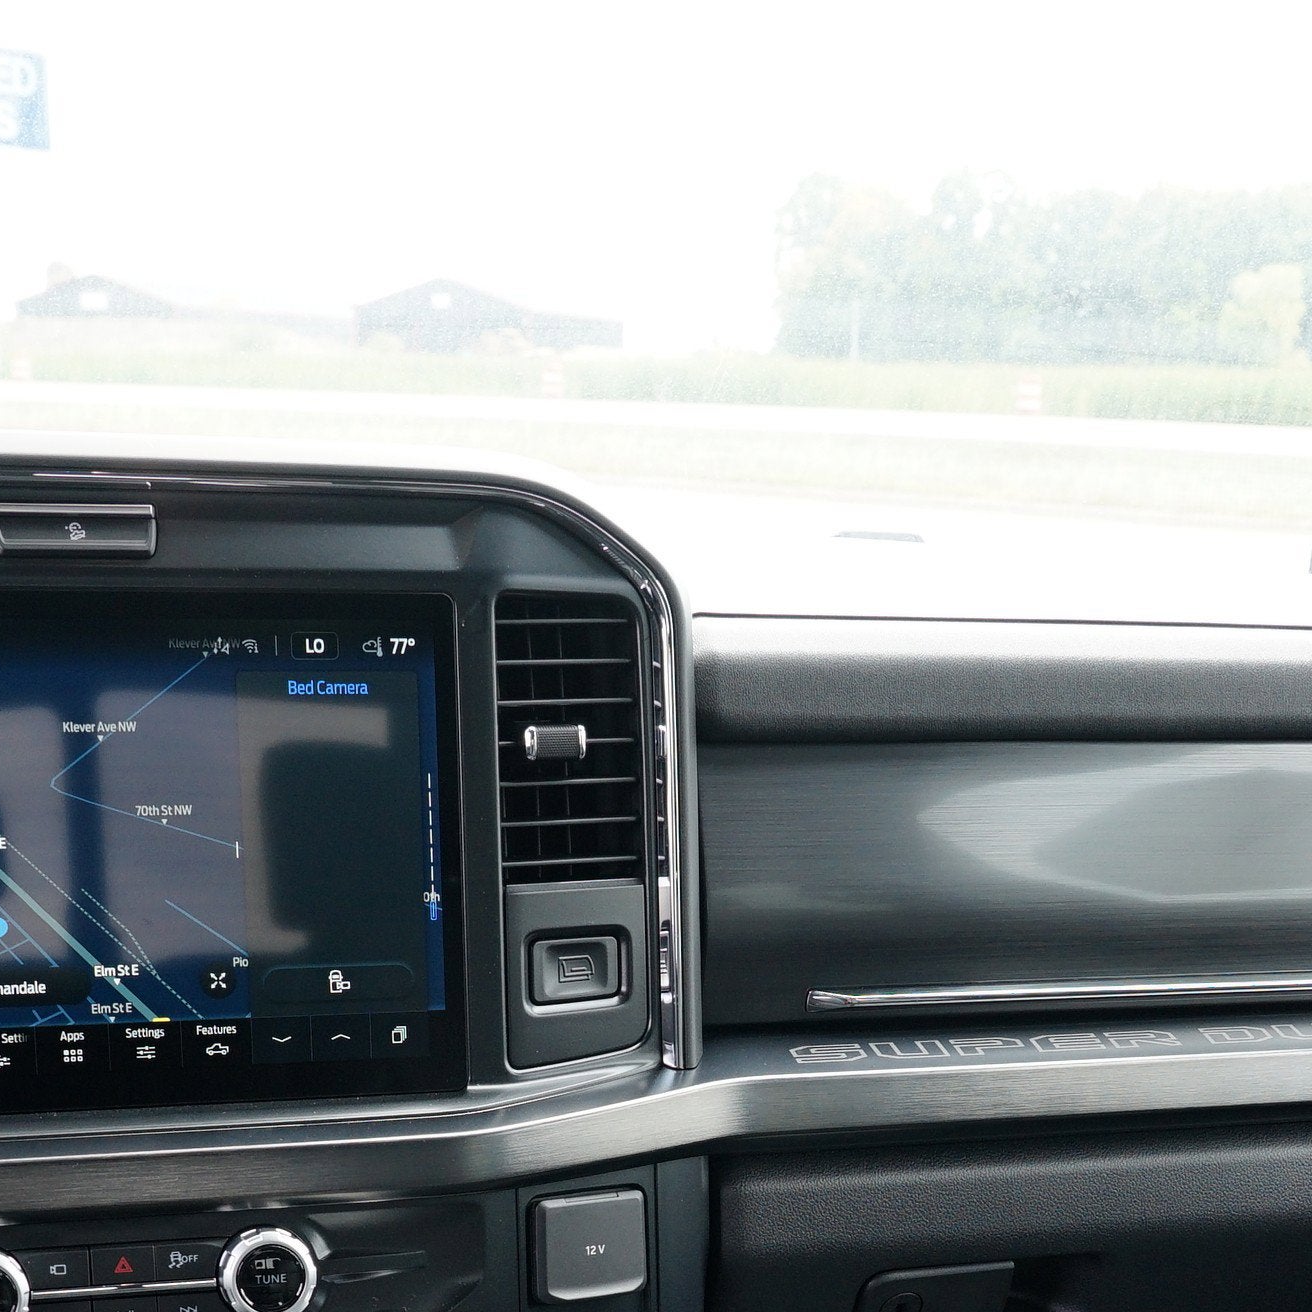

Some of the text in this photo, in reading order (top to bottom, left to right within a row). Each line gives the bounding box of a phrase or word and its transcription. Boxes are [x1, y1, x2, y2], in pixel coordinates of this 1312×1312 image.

[305, 637, 416, 655] LO 77°
[288, 680, 369, 696] Bed Camera
[63, 721, 137, 733] Klever Ave NW
[135, 804, 193, 817] 70th St NW
[94, 963, 139, 977] Elm St E
[91, 1002, 133, 1015] Elm St E
[60, 1030, 85, 1043] Apps
[125, 1027, 165, 1041] Settings
[196, 1024, 237, 1036] Features
[788, 1027, 1182, 1065] SUPER
[585, 1244, 606, 1256] 12 V
[181, 1254, 199, 1264] OFF
[255, 1273, 288, 1285] TUNE
